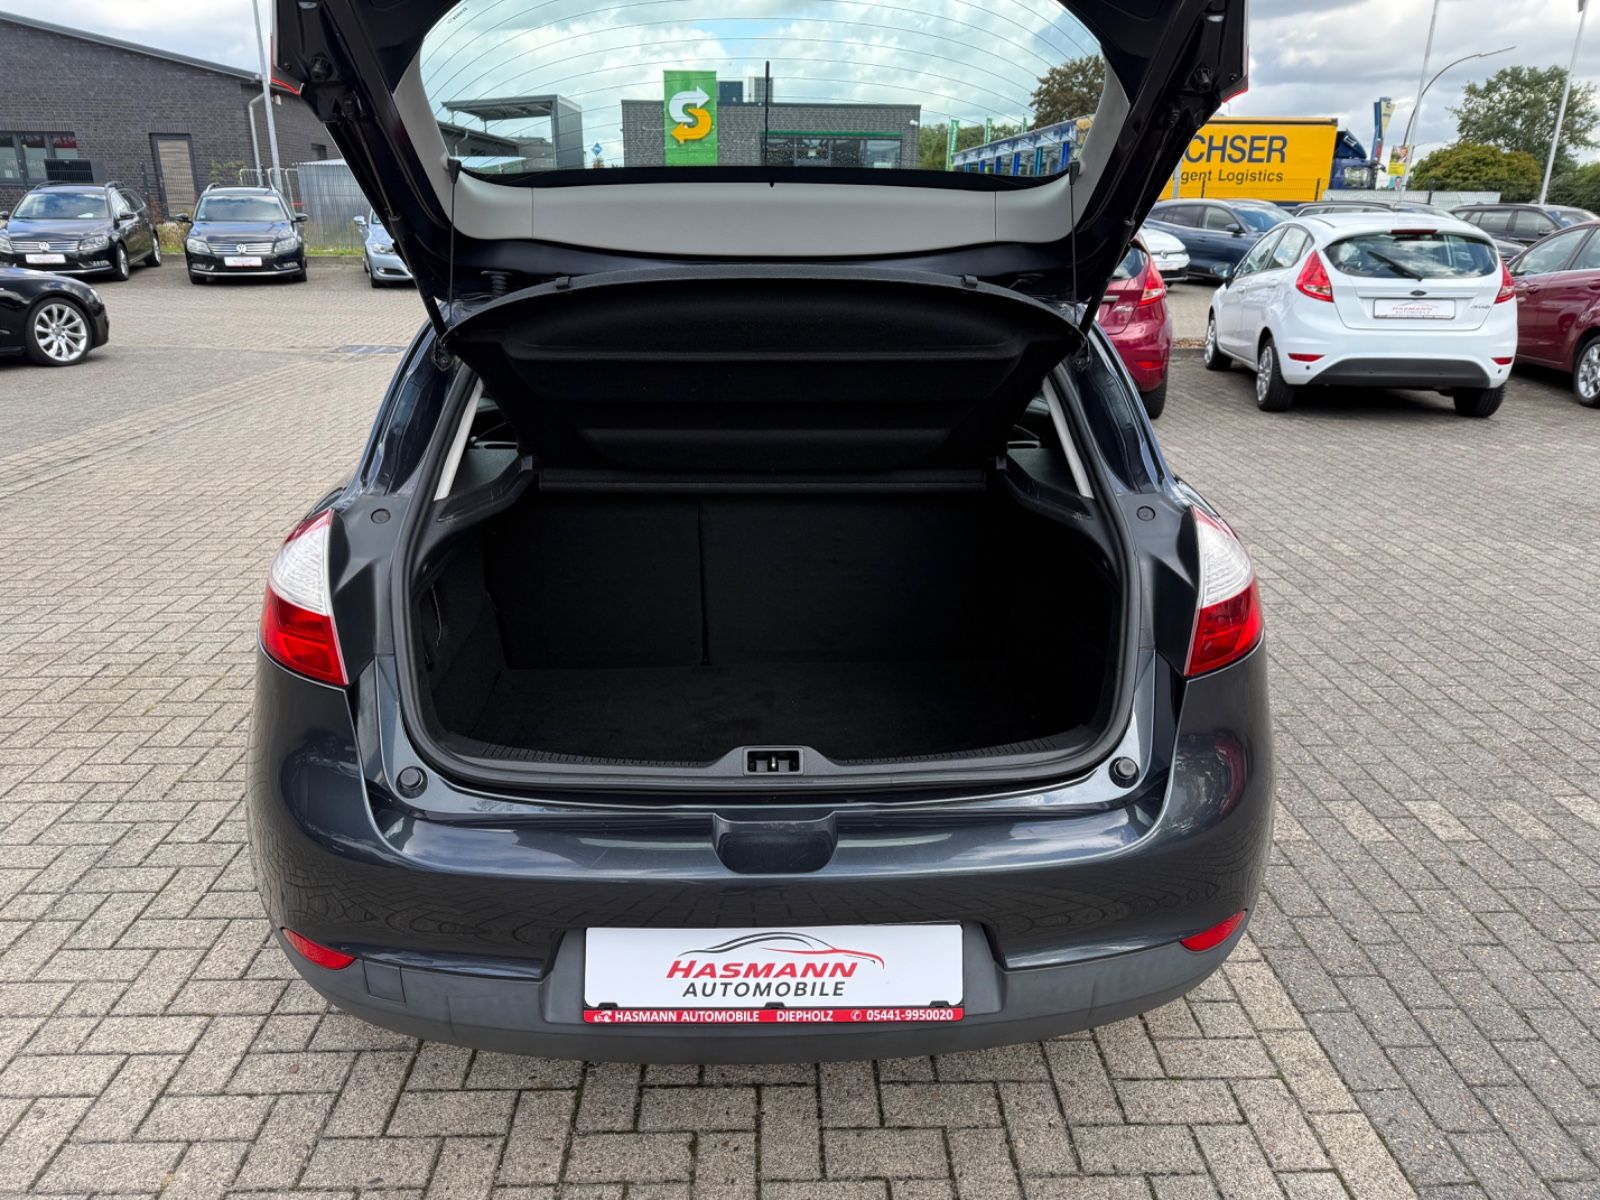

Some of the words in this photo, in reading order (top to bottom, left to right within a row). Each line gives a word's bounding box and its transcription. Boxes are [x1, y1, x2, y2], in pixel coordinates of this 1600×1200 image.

[1182, 134, 1288, 163] CHSER
[1180, 169, 1212, 184] gent
[1218, 169, 1284, 184] Logistics
[666, 959, 858, 979] HASMANN
[682, 981, 846, 998] AUTOMOBILE
[615, 1010, 677, 1022] HASMANN
[681, 1010, 760, 1022] AUTOMOBILE
[776, 1010, 834, 1022] DIEPHOLZ
[866, 1009, 954, 1021] 05441-9950020
